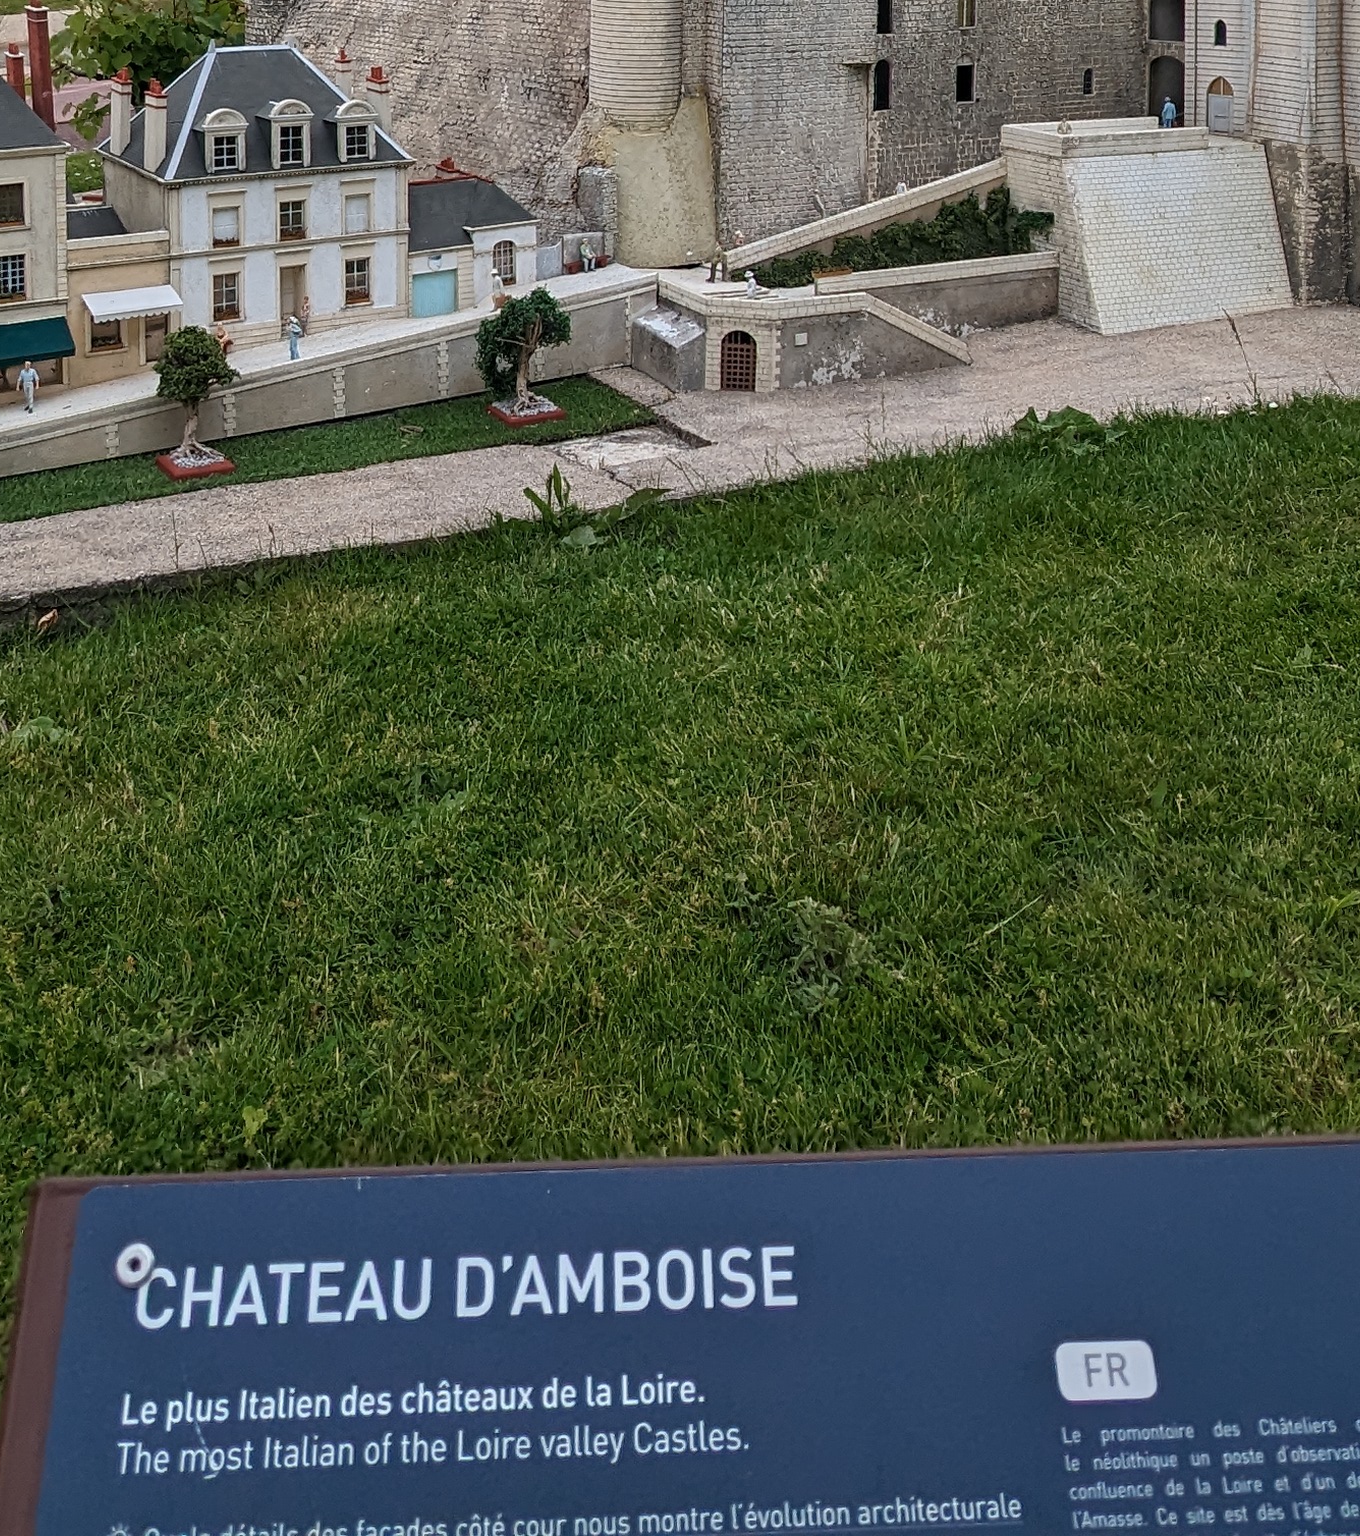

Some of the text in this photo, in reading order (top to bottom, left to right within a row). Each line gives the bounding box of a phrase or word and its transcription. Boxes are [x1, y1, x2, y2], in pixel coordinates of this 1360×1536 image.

[136, 1246, 797, 1329] CHATEAU D'AMBOISE
[1084, 1353, 1129, 1388] FR
[122, 1374, 704, 1432] Le plus Italien des châteaux de la Loire.
[117, 1420, 749, 1475] The most Italian of the Loire valley Castles.
[1062, 1427, 1081, 1443] Le
[1101, 1425, 1194, 1446] promontoire
[1213, 1421, 1240, 1437] des
[1065, 1455, 1080, 1471] le
[1093, 1451, 1177, 1472] néolithique
[1190, 1454, 1210, 1466] un
[1223, 1449, 1264, 1469] poste
[1069, 1482, 1153, 1500] confluence
[1166, 1479, 1184, 1496] de
[1196, 1478, 1211, 1494] la
[1222, 1476, 1262, 1494] Loire
[1274, 1476, 1290, 1492] et
[1301, 1473, 1336, 1491] d'un
[456, 1514, 505, 1536] côté
[514, 1519, 567, 1536] cour
[575, 1516, 630, 1536] nous
[639, 1508, 723, 1533] montre
[732, 1501, 850, 1529] l'évolution
[858, 1493, 1021, 1524] architecturale
[1156, 1508, 1177, 1525] Ce
[1186, 1508, 1215, 1524] site
[1224, 1506, 1248, 1522] est
[1257, 1503, 1285, 1521] dès
[1293, 1501, 1331, 1524] l'âge
[1341, 1500, 1359, 1518] de
